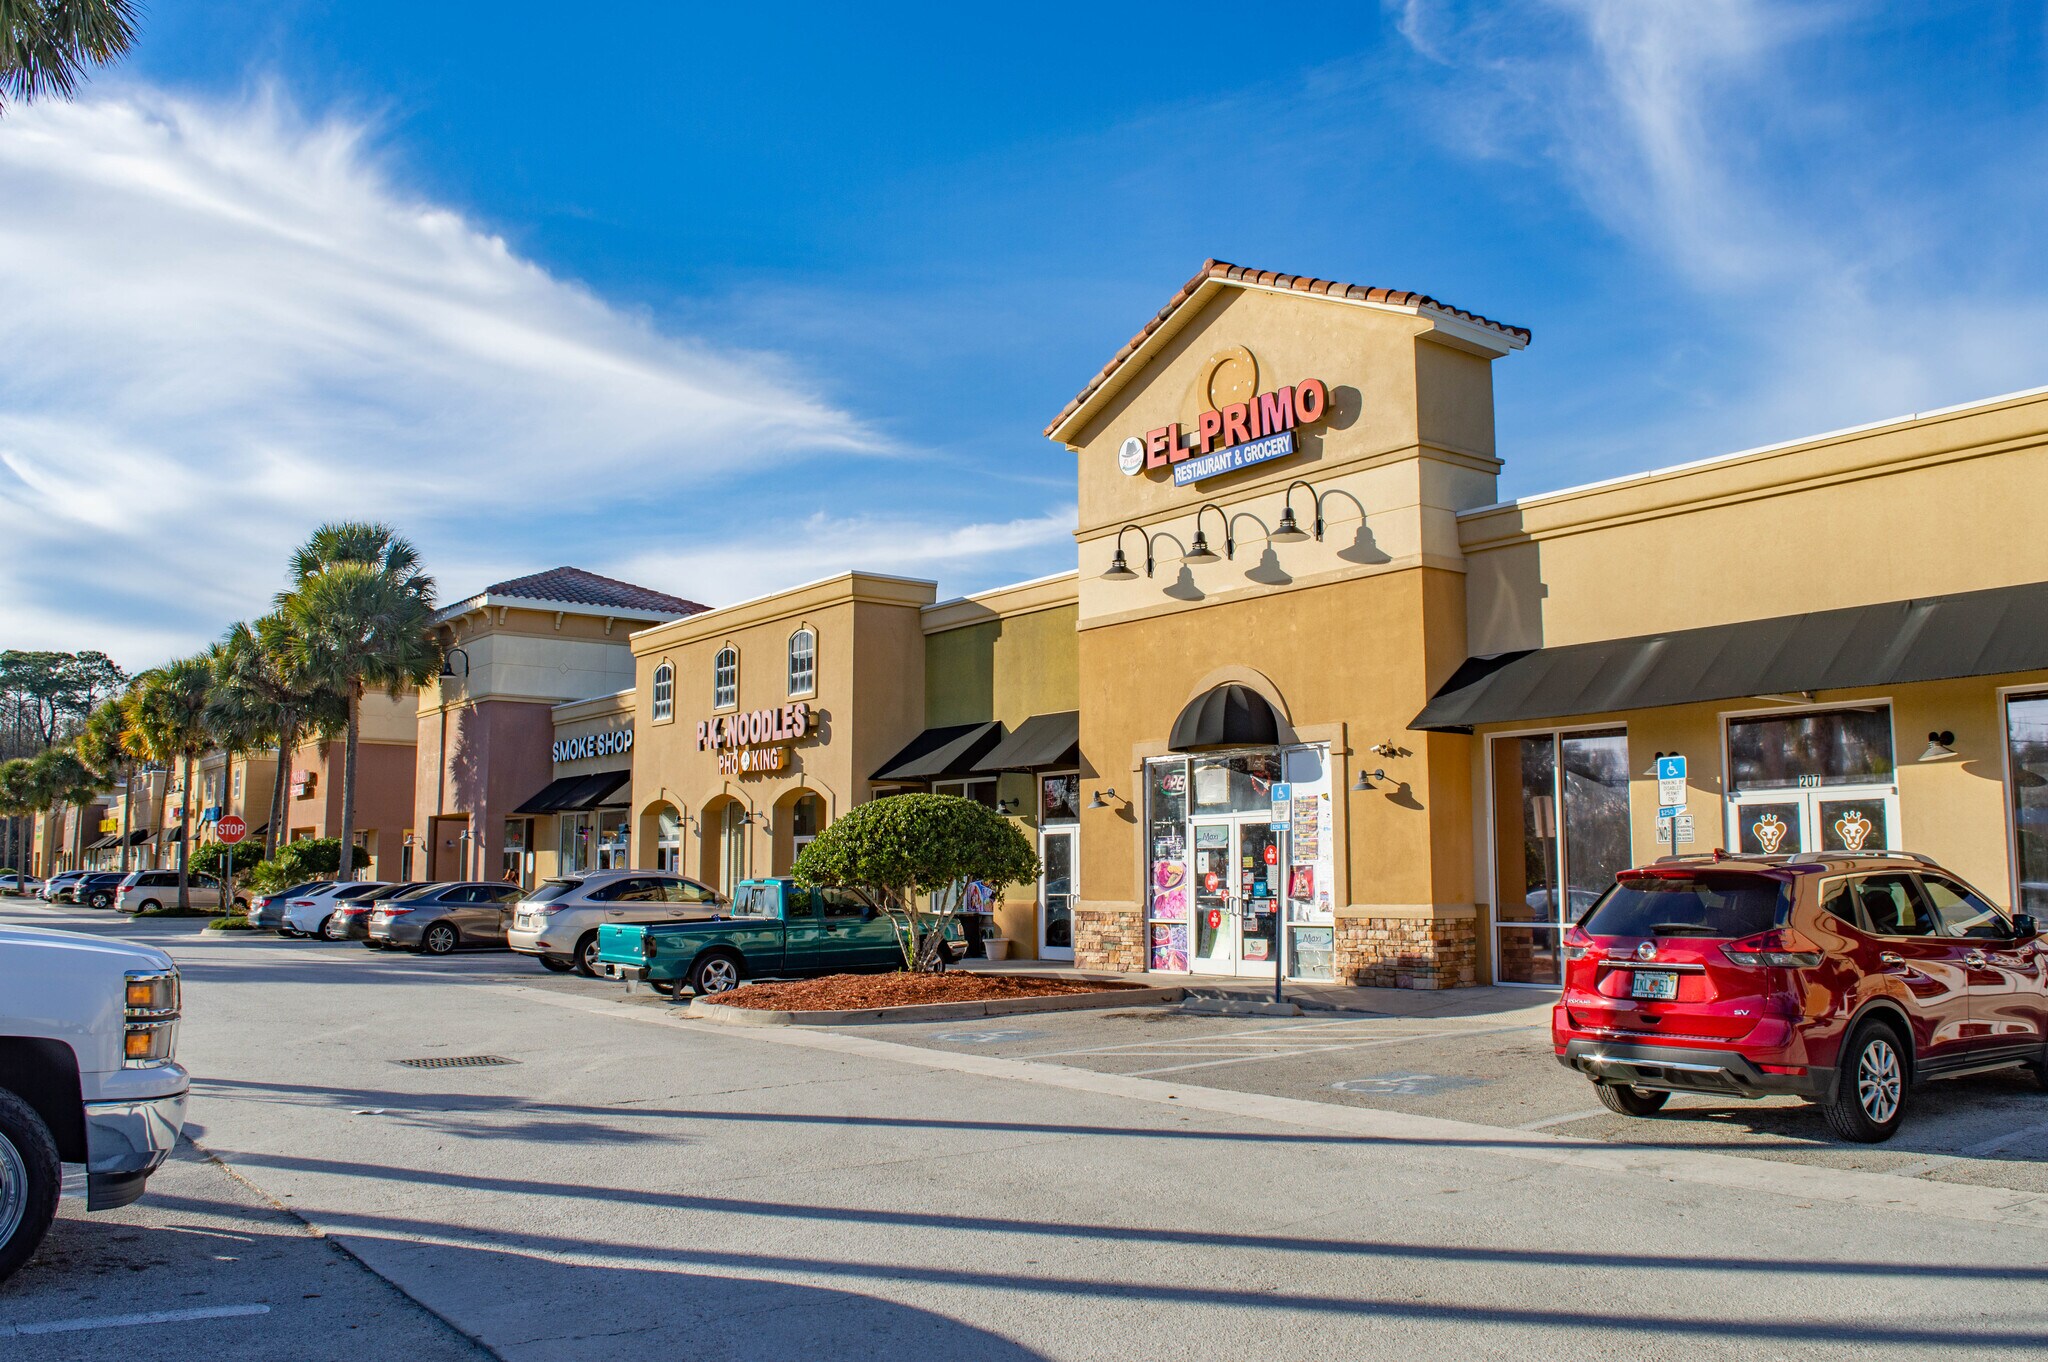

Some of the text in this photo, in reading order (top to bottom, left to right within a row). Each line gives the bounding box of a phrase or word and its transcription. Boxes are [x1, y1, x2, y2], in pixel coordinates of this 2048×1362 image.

[1147, 378, 1325, 469] EL PRIMO
[1175, 435, 1291, 483] RESTAURANT & GROCERY
[727, 702, 807, 748] NOODLES
[552, 729, 633, 762] SMOKE SHOP
[752, 747, 778, 771] KING
[1800, 775, 1820, 787] 207
[218, 824, 245, 835] STOP
[1202, 832, 1219, 841] Maxi
[1658, 826, 1668, 840] NO
[1303, 933, 1322, 943] Maxi
